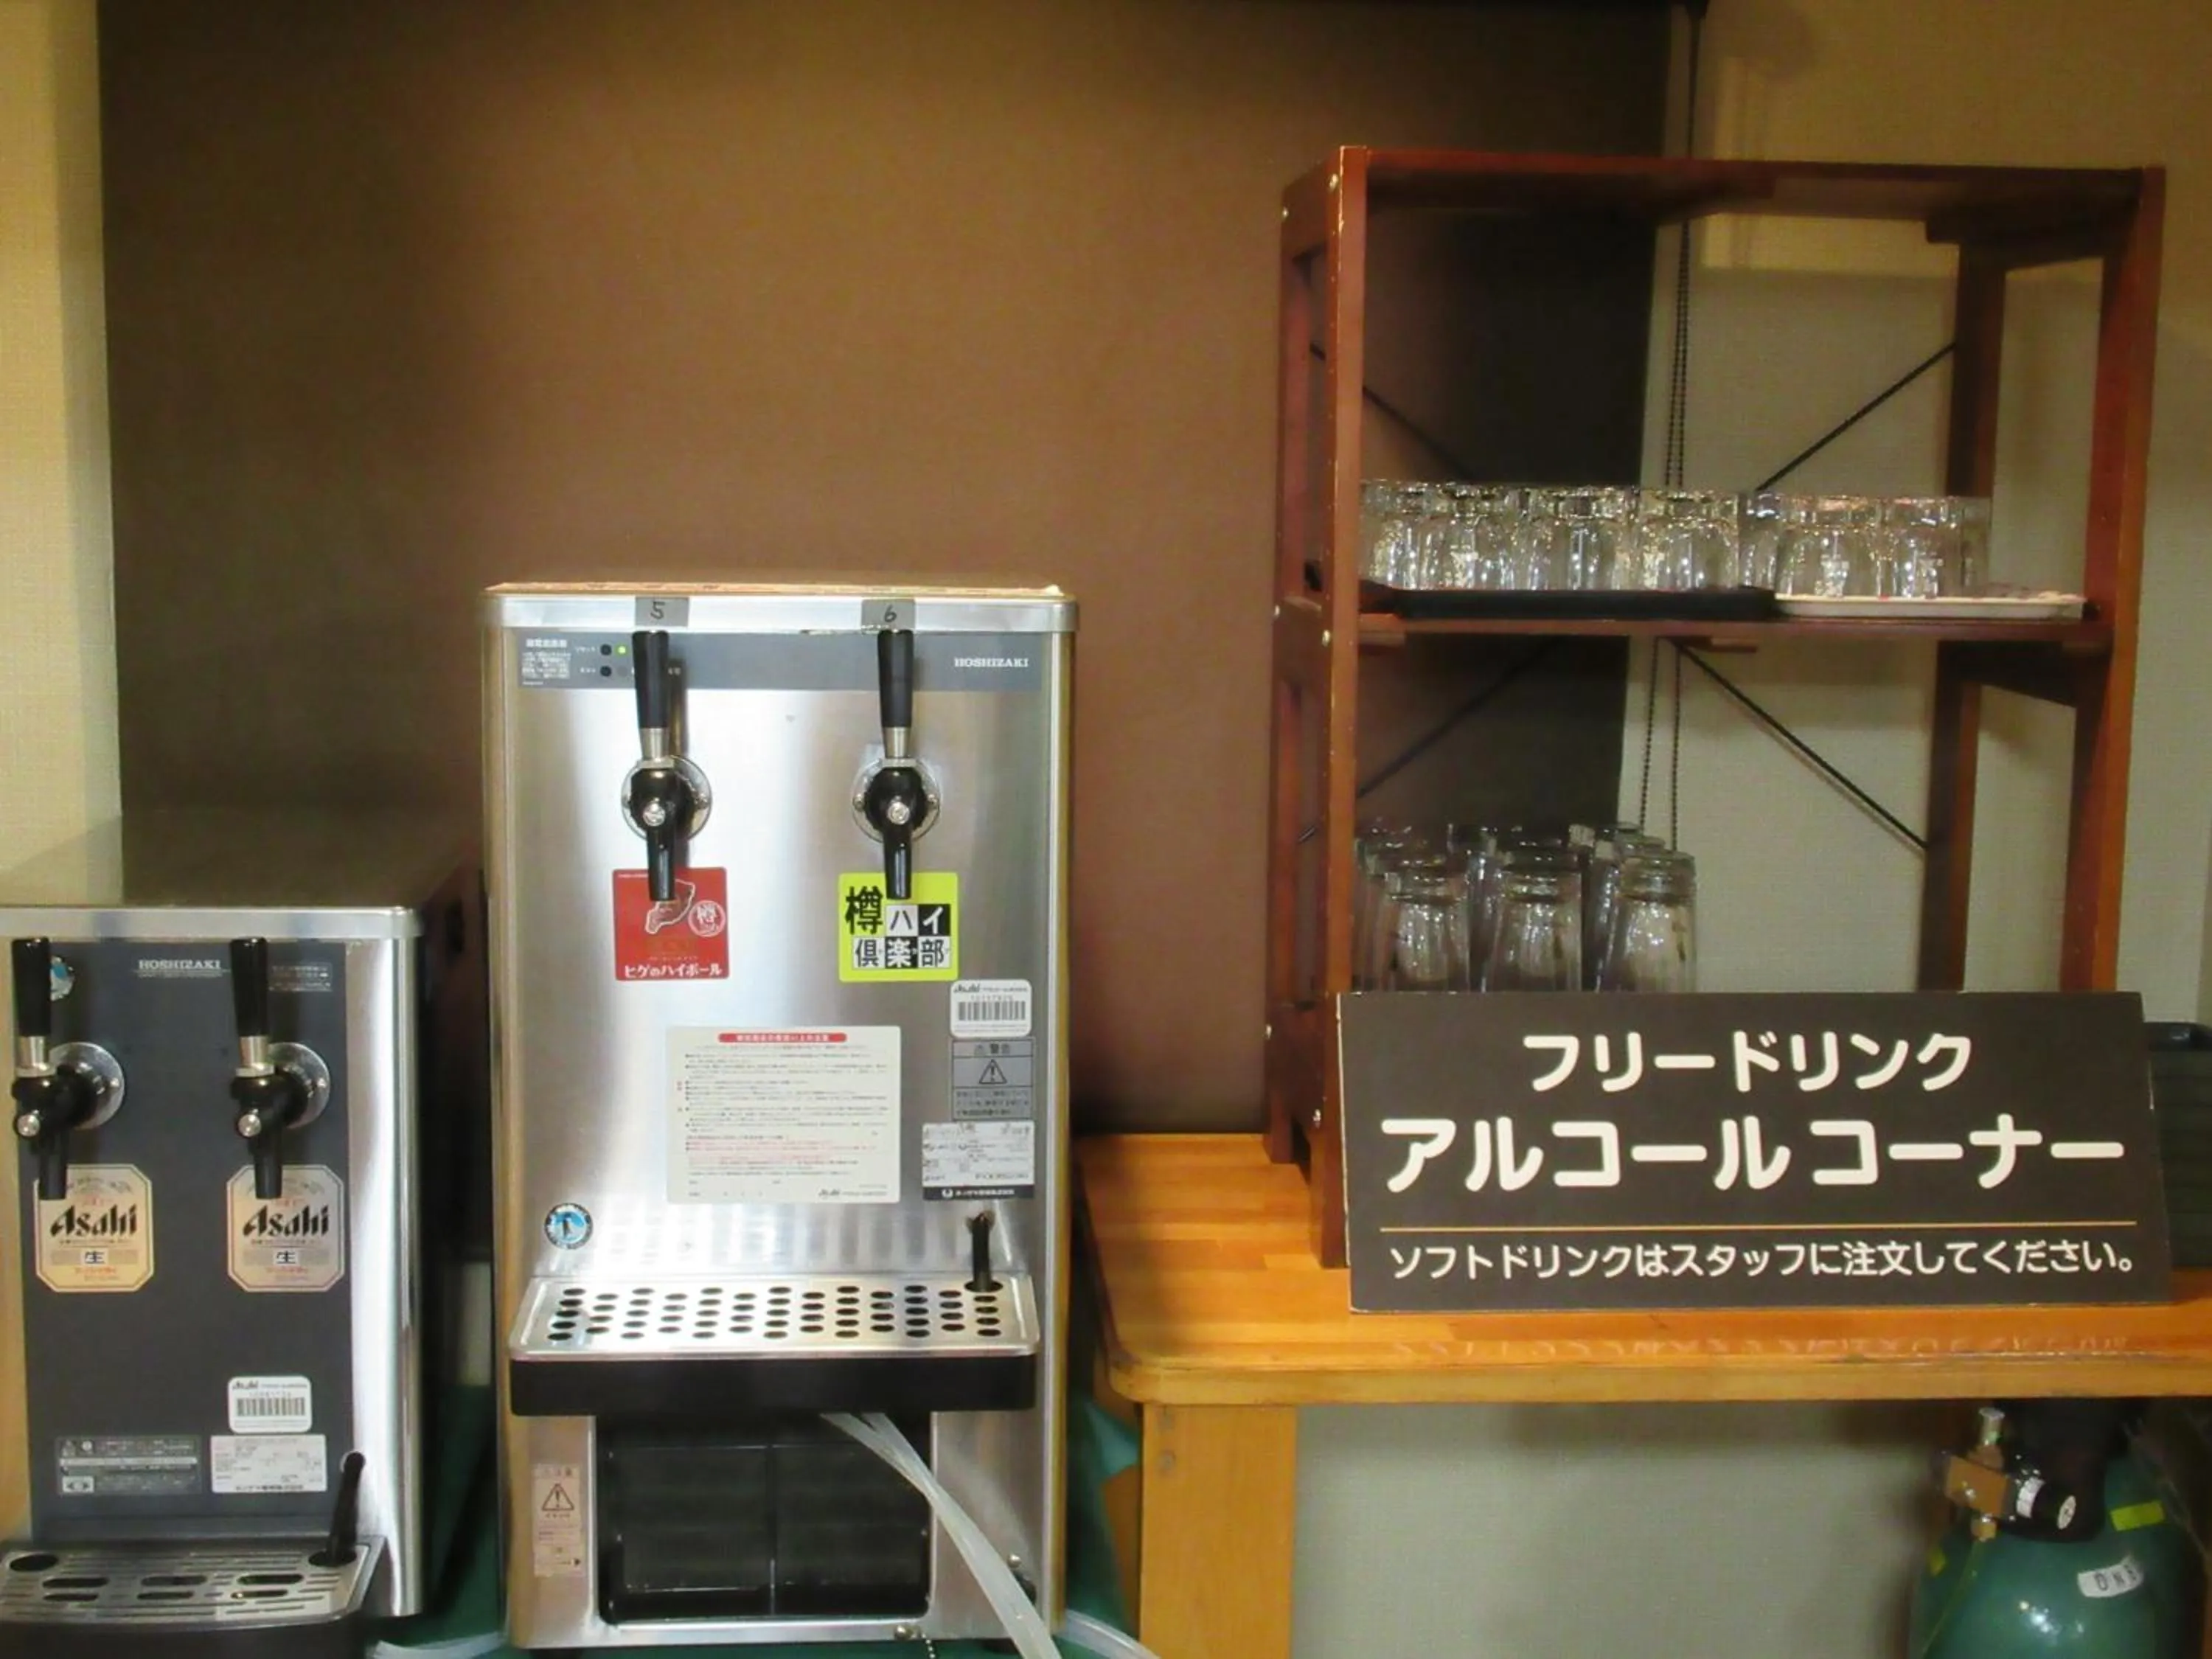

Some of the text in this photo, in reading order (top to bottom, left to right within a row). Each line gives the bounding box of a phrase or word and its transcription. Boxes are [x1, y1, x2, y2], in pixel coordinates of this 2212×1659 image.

[650, 601, 665, 619] 5
[884, 604, 897, 623] 6
[954, 657, 1029, 667] HOSHIZAKI
[845, 886, 944, 935] 樽ハイ
[139, 959, 221, 970] HOSHIZAKI
[1523, 1030, 1972, 1093] フリードリンク
[50, 1203, 137, 1237] Asahi
[243, 1205, 329, 1237] Asahi
[85, 1251, 105, 1264] 生
[276, 1251, 296, 1264] 生
[1390, 1239, 2133, 1280] ソフトドリンクはスタッフに注文してください。
